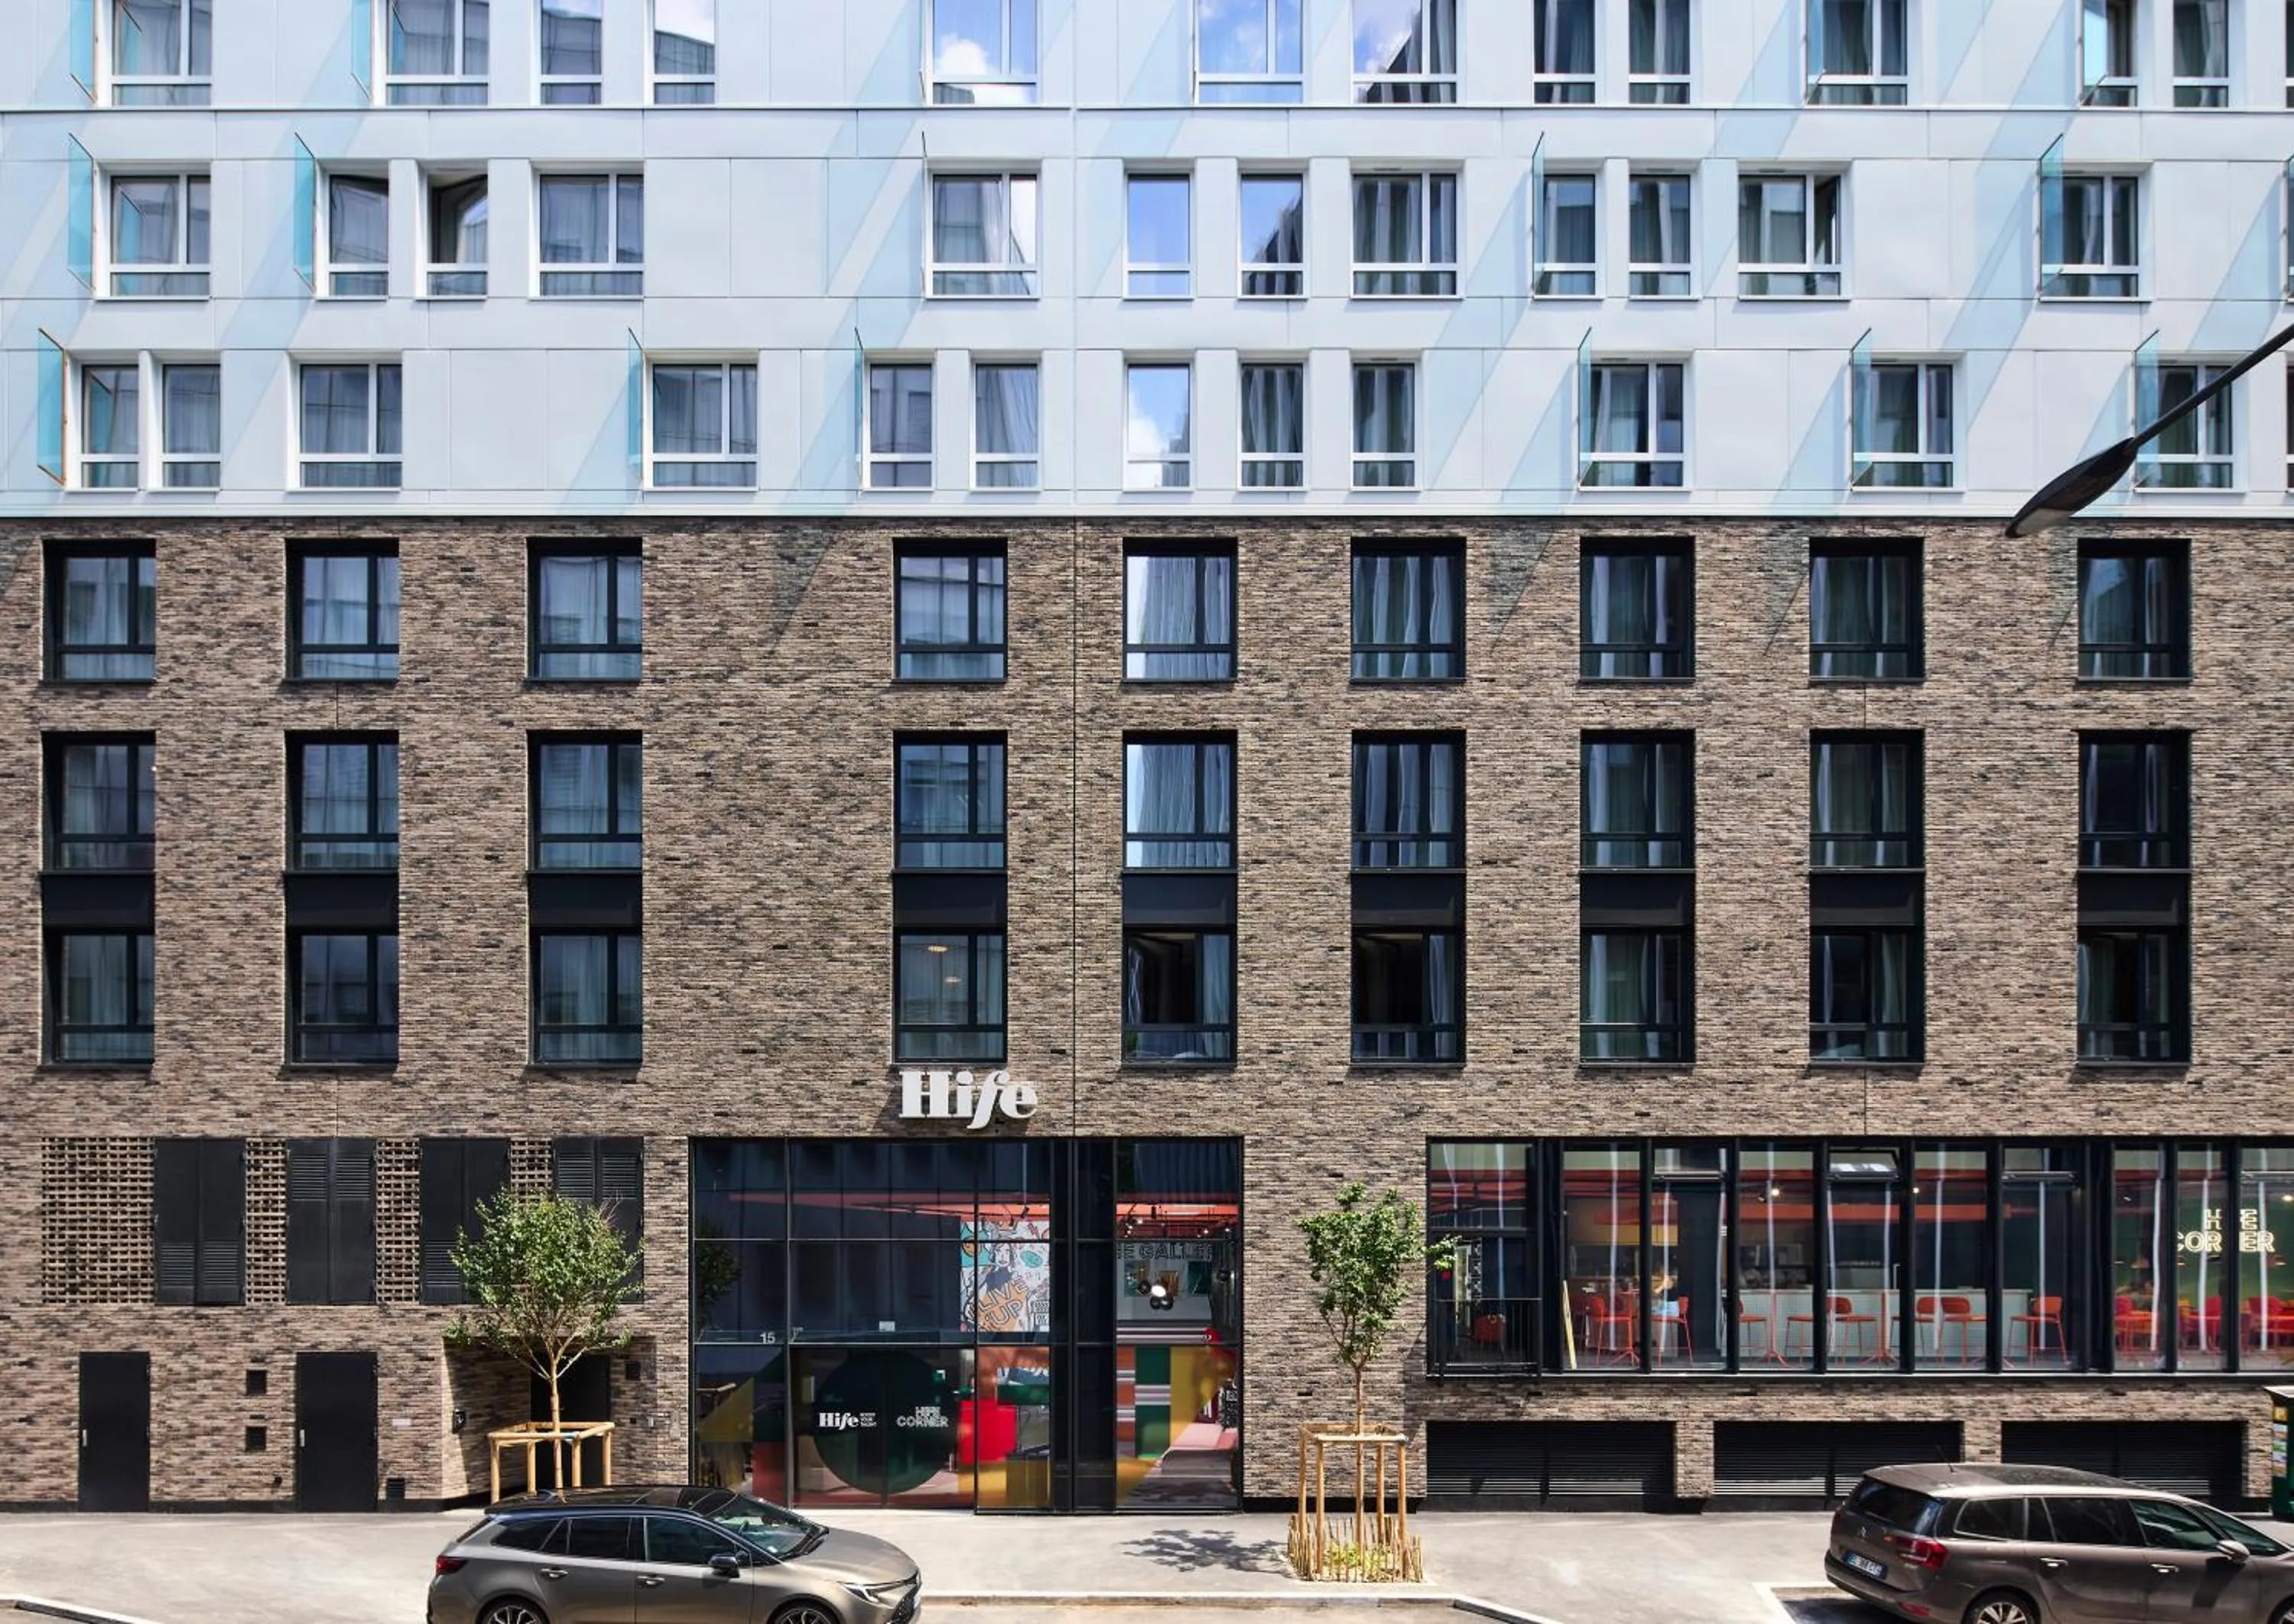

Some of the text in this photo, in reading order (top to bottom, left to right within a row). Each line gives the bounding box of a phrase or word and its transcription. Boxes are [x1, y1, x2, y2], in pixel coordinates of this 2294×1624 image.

[899, 1069, 1038, 1130] Hife
[2205, 1208, 2258, 1230] HE
[2178, 1231, 2276, 1252] ORER
[760, 1331, 776, 1344] 15
[819, 1412, 859, 1431] Hife
